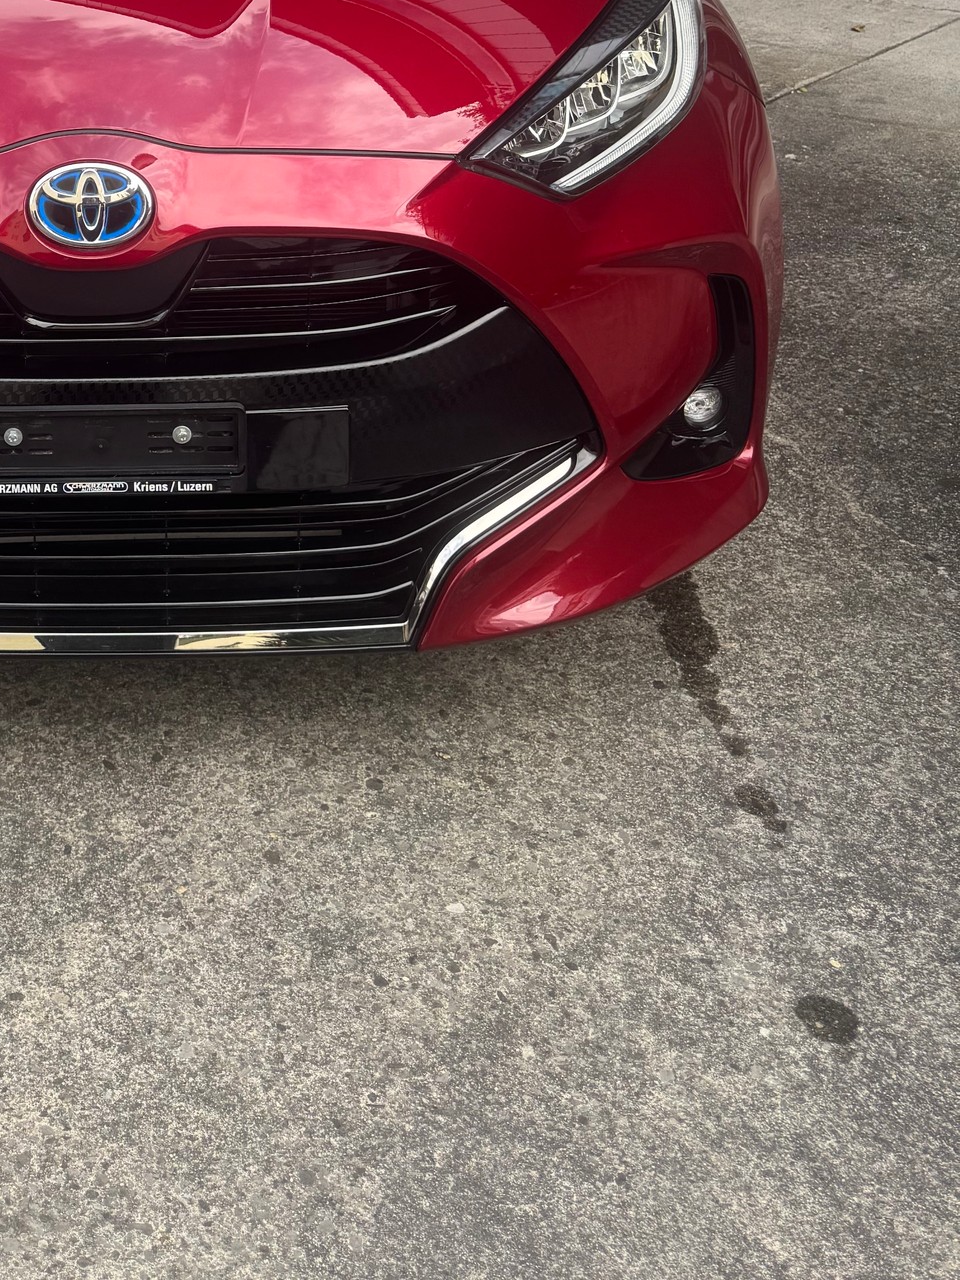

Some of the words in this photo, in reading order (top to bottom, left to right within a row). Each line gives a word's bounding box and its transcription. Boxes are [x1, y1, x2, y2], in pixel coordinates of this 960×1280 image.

[43, 482, 58, 493] AG
[133, 481, 168, 492] Kriens
[177, 481, 213, 492] Luzern
